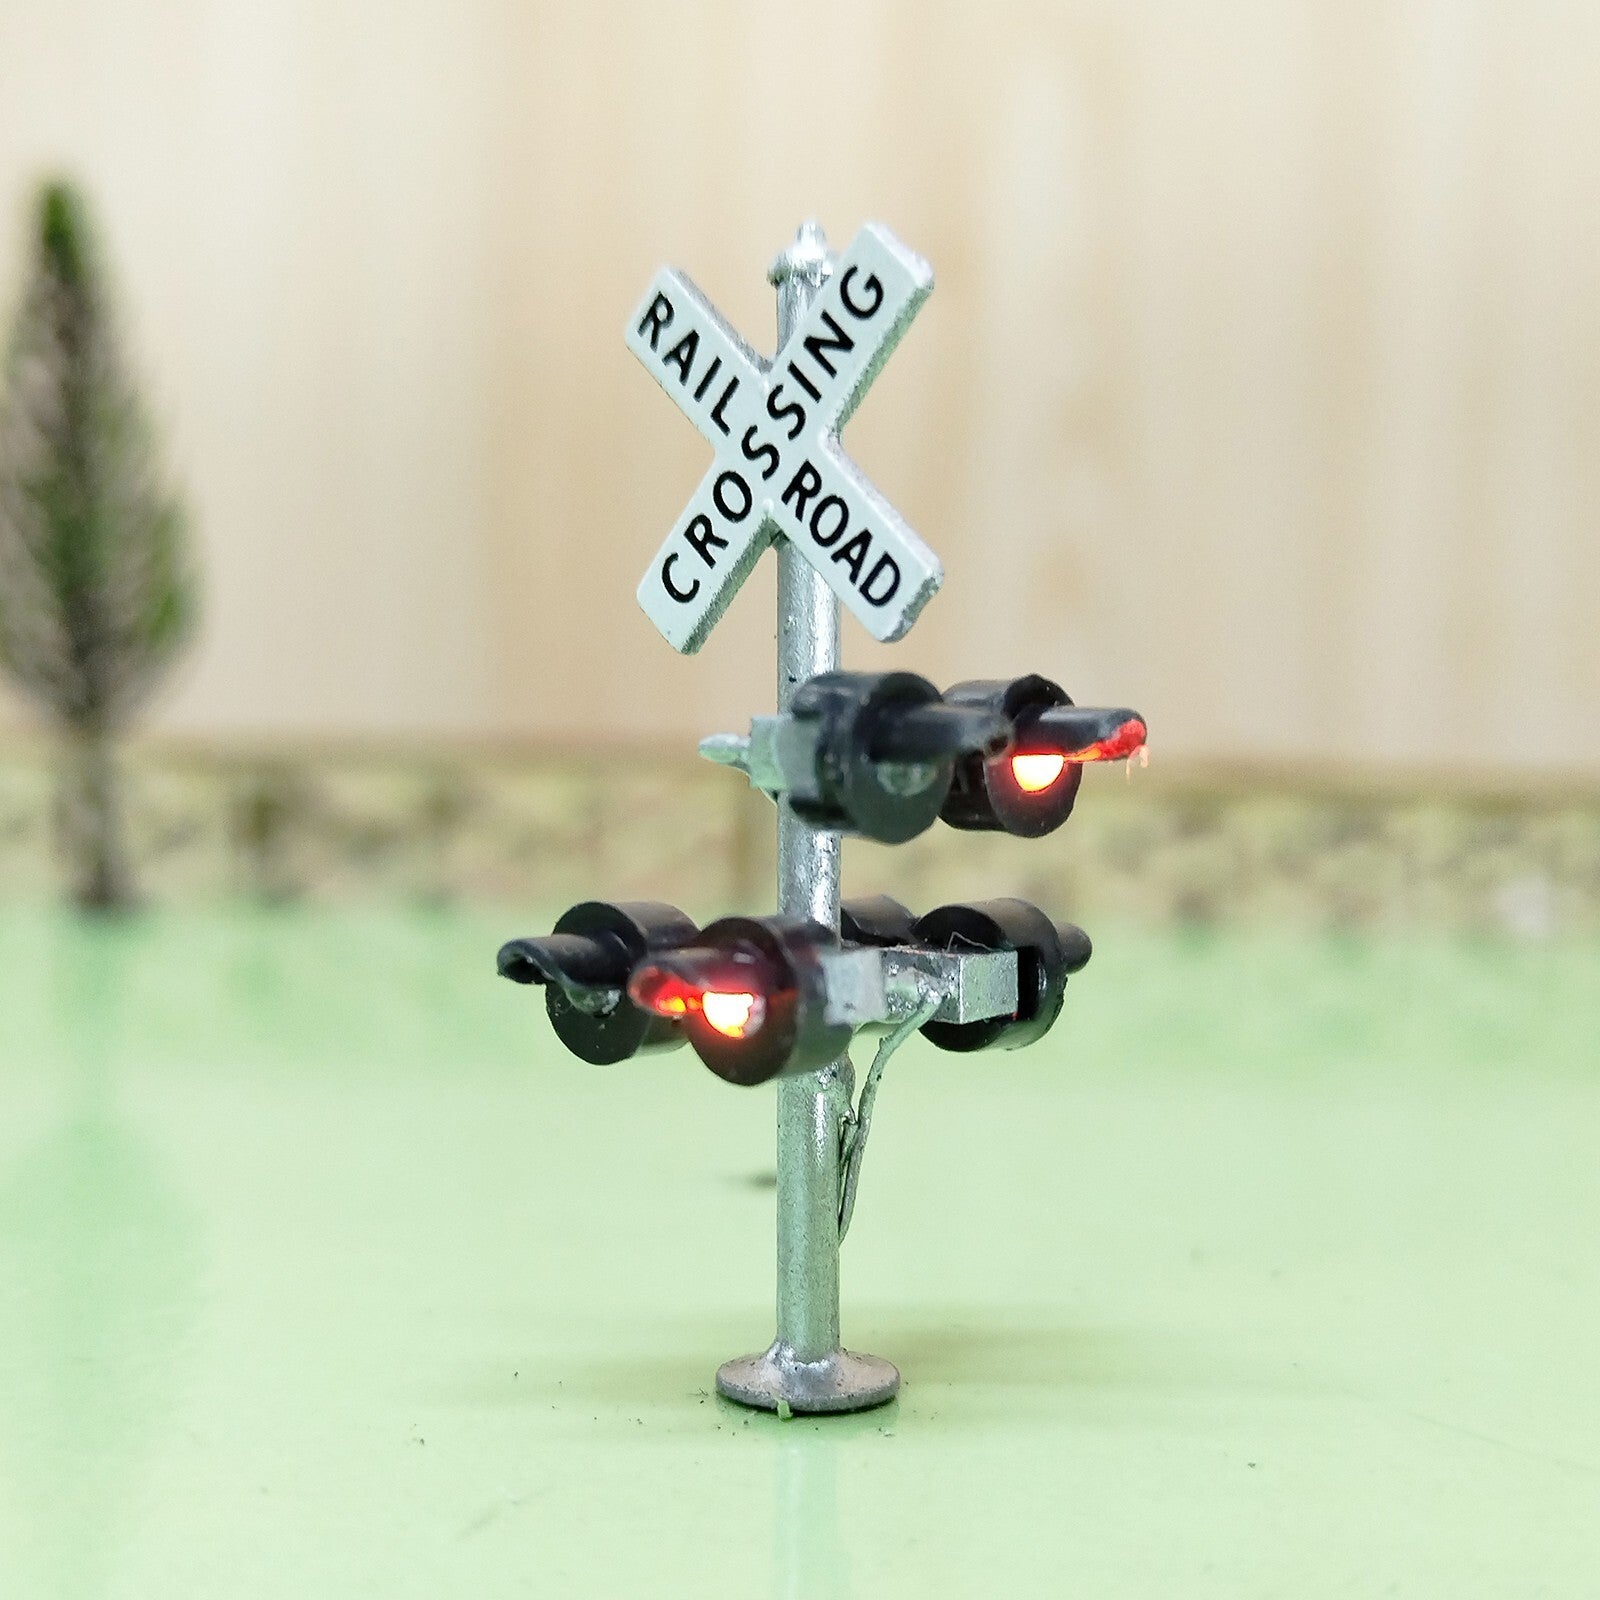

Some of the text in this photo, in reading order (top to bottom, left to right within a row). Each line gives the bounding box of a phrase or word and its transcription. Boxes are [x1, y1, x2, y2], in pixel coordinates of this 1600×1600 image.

[638, 290, 901, 608] RAIL ROAD
[660, 265, 884, 604] CROSSING
